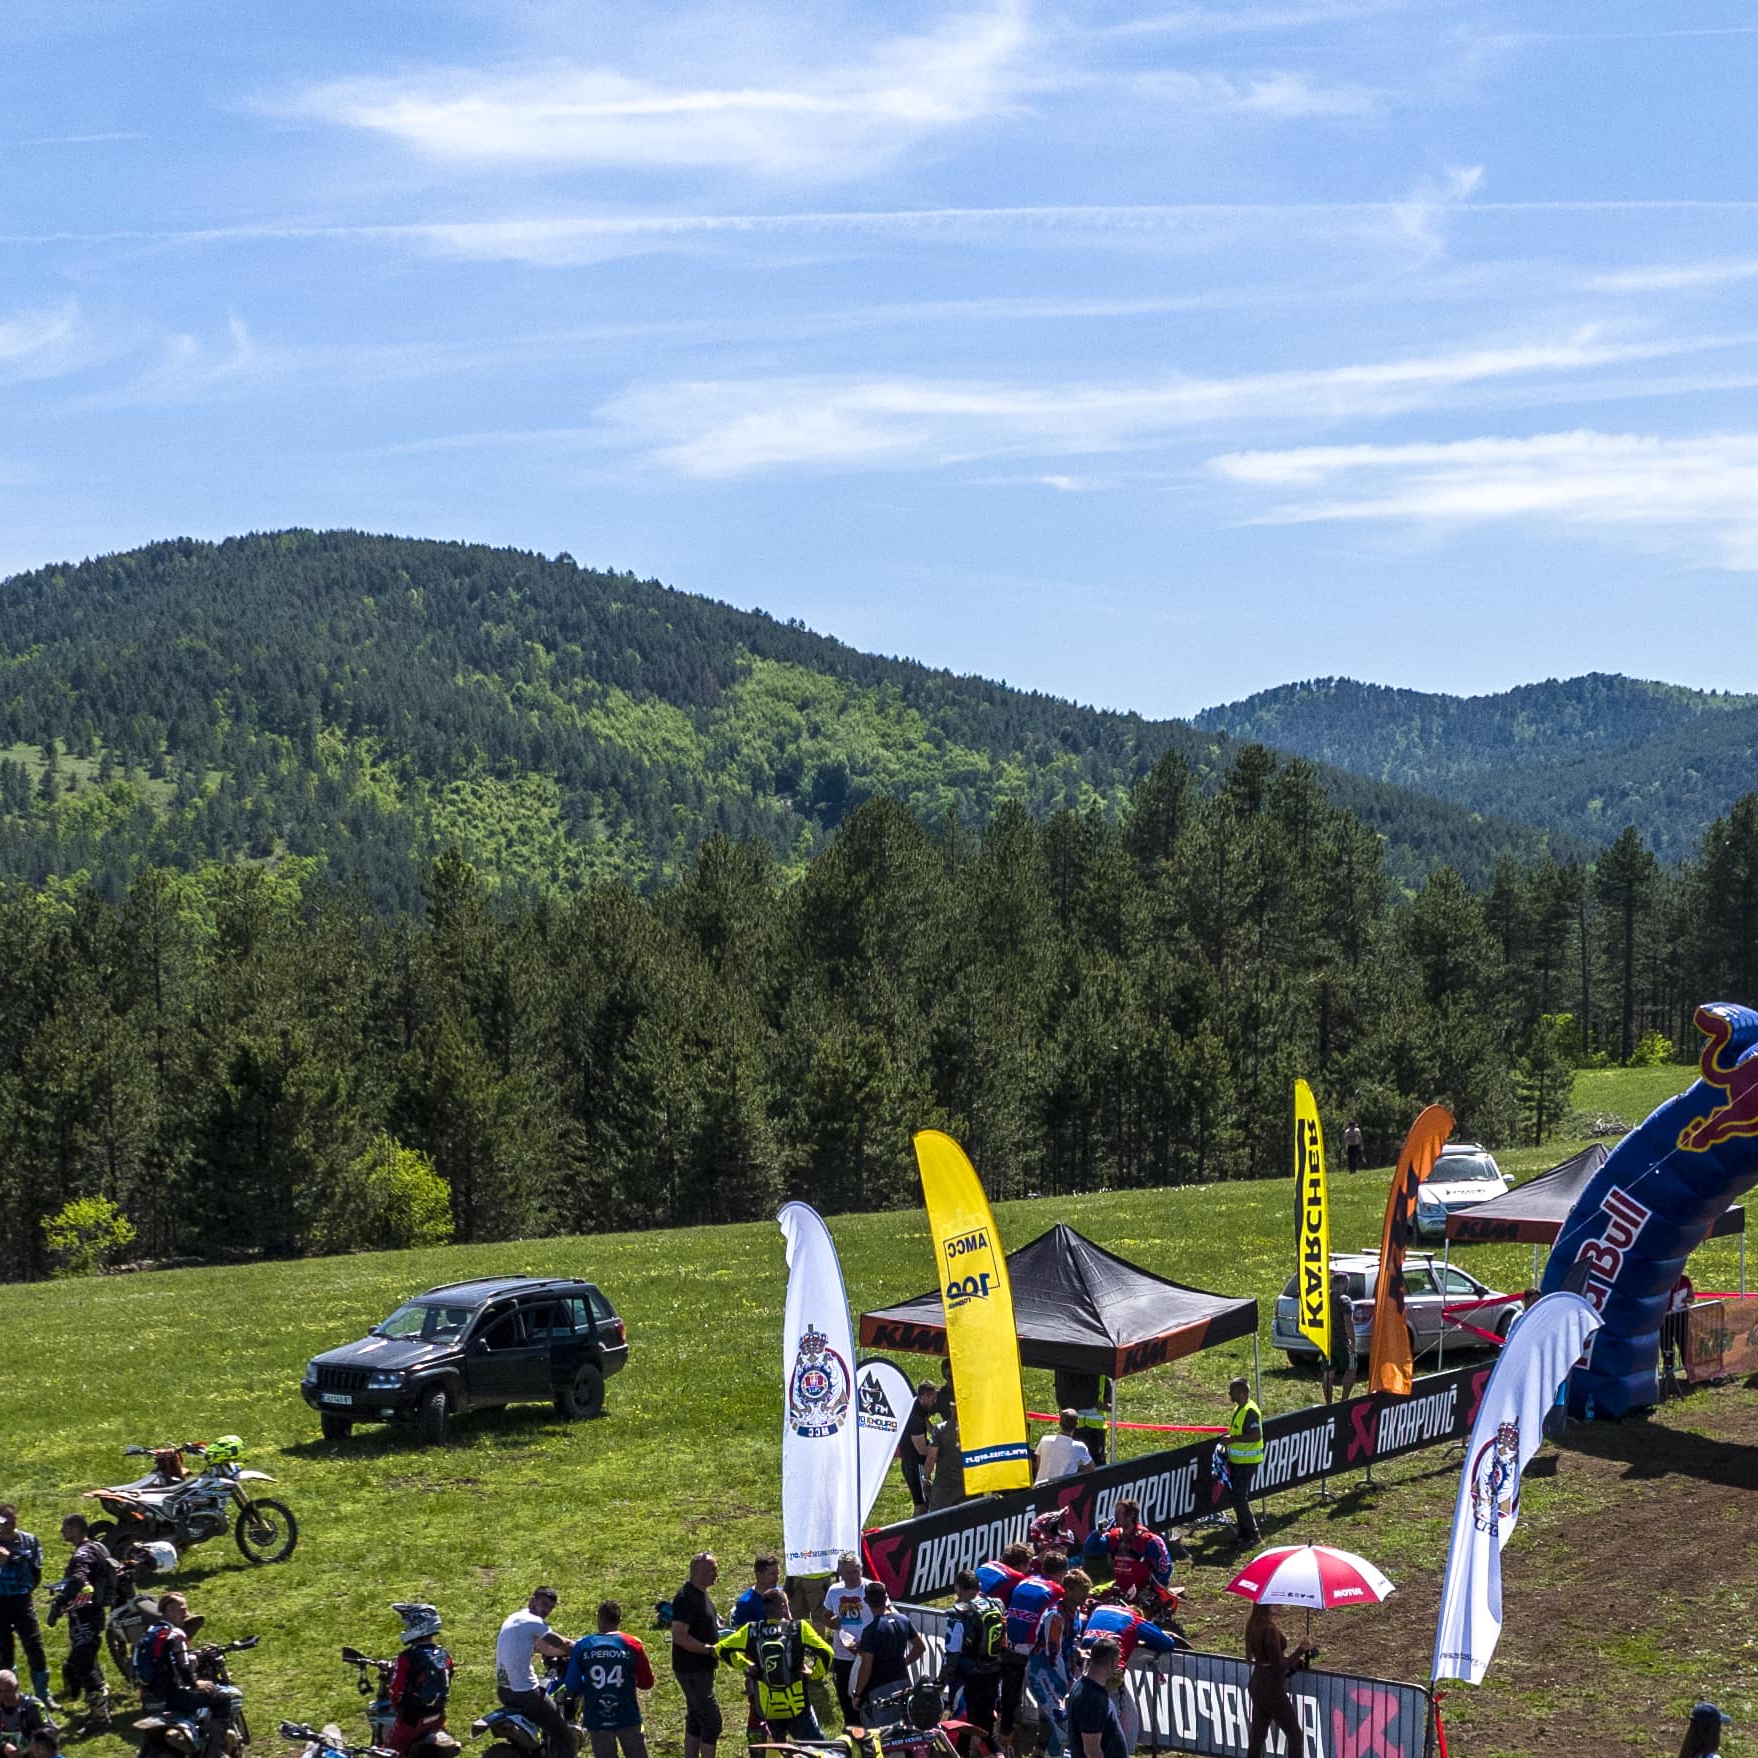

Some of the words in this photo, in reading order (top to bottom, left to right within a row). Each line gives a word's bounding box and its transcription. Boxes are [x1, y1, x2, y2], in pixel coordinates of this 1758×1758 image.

[1577, 1185, 1652, 1285] Bull
[1123, 1338, 1168, 1376] KTM
[1375, 1384, 1458, 1454] AKRAPOVIČ
[1248, 1417, 1336, 1494] KRAPOVIČ
[1333, 1587, 1364, 1599] MOTUL
[589, 1664, 625, 1690] 94
